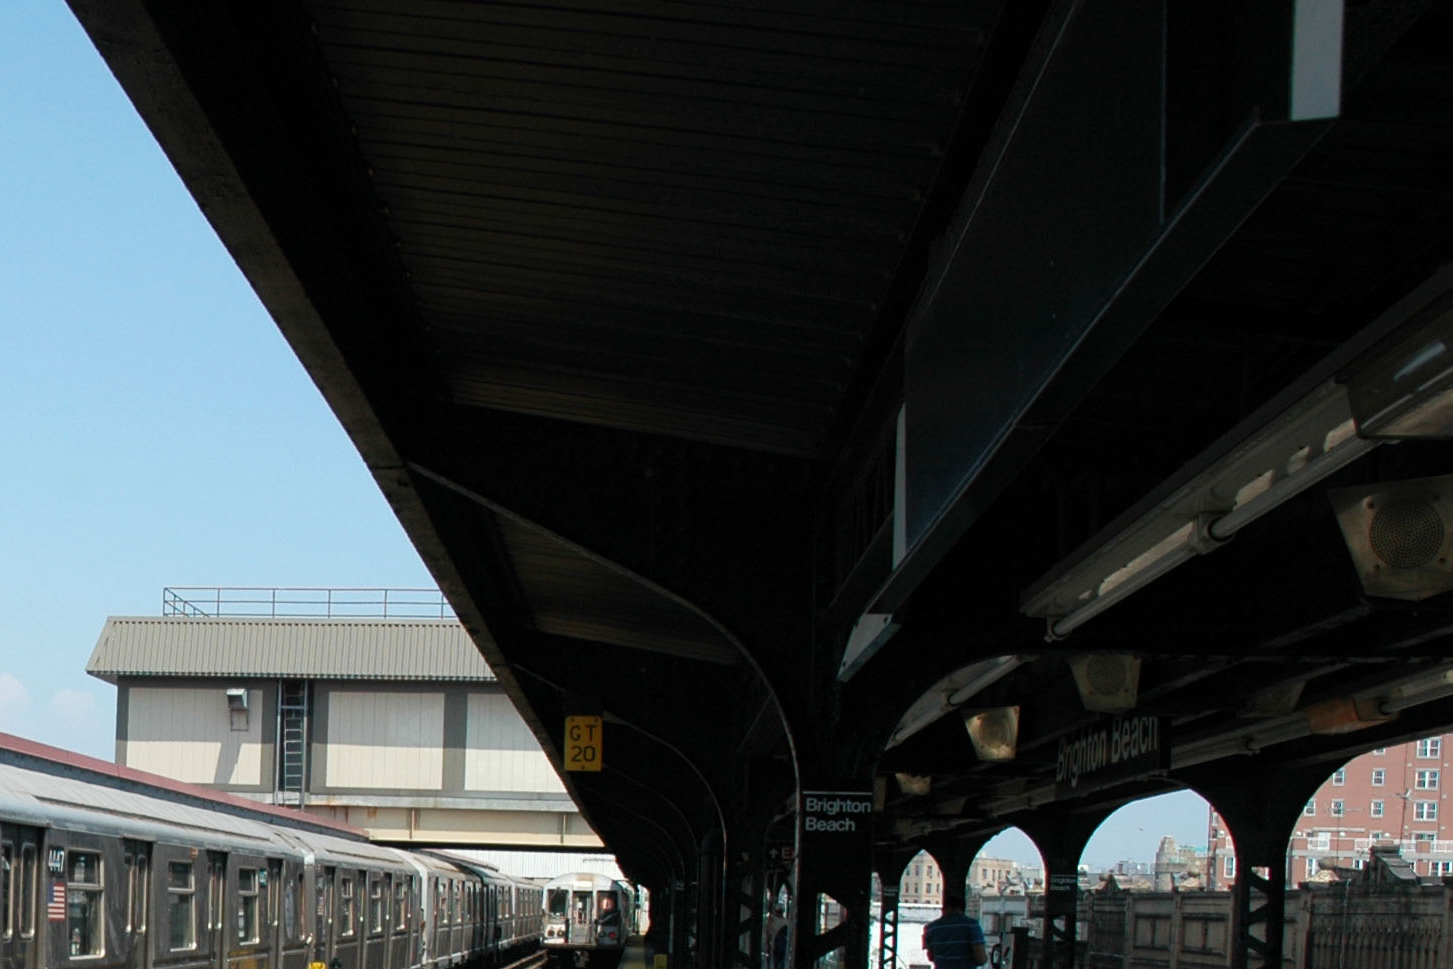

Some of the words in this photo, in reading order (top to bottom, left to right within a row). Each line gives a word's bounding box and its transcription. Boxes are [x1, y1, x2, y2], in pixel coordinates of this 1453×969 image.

[570, 744, 596, 763] 20
[1056, 729, 1107, 788] Brighton
[1111, 716, 1158, 763] Beach
[804, 797, 872, 816] Brighton
[804, 815, 856, 832] Beach
